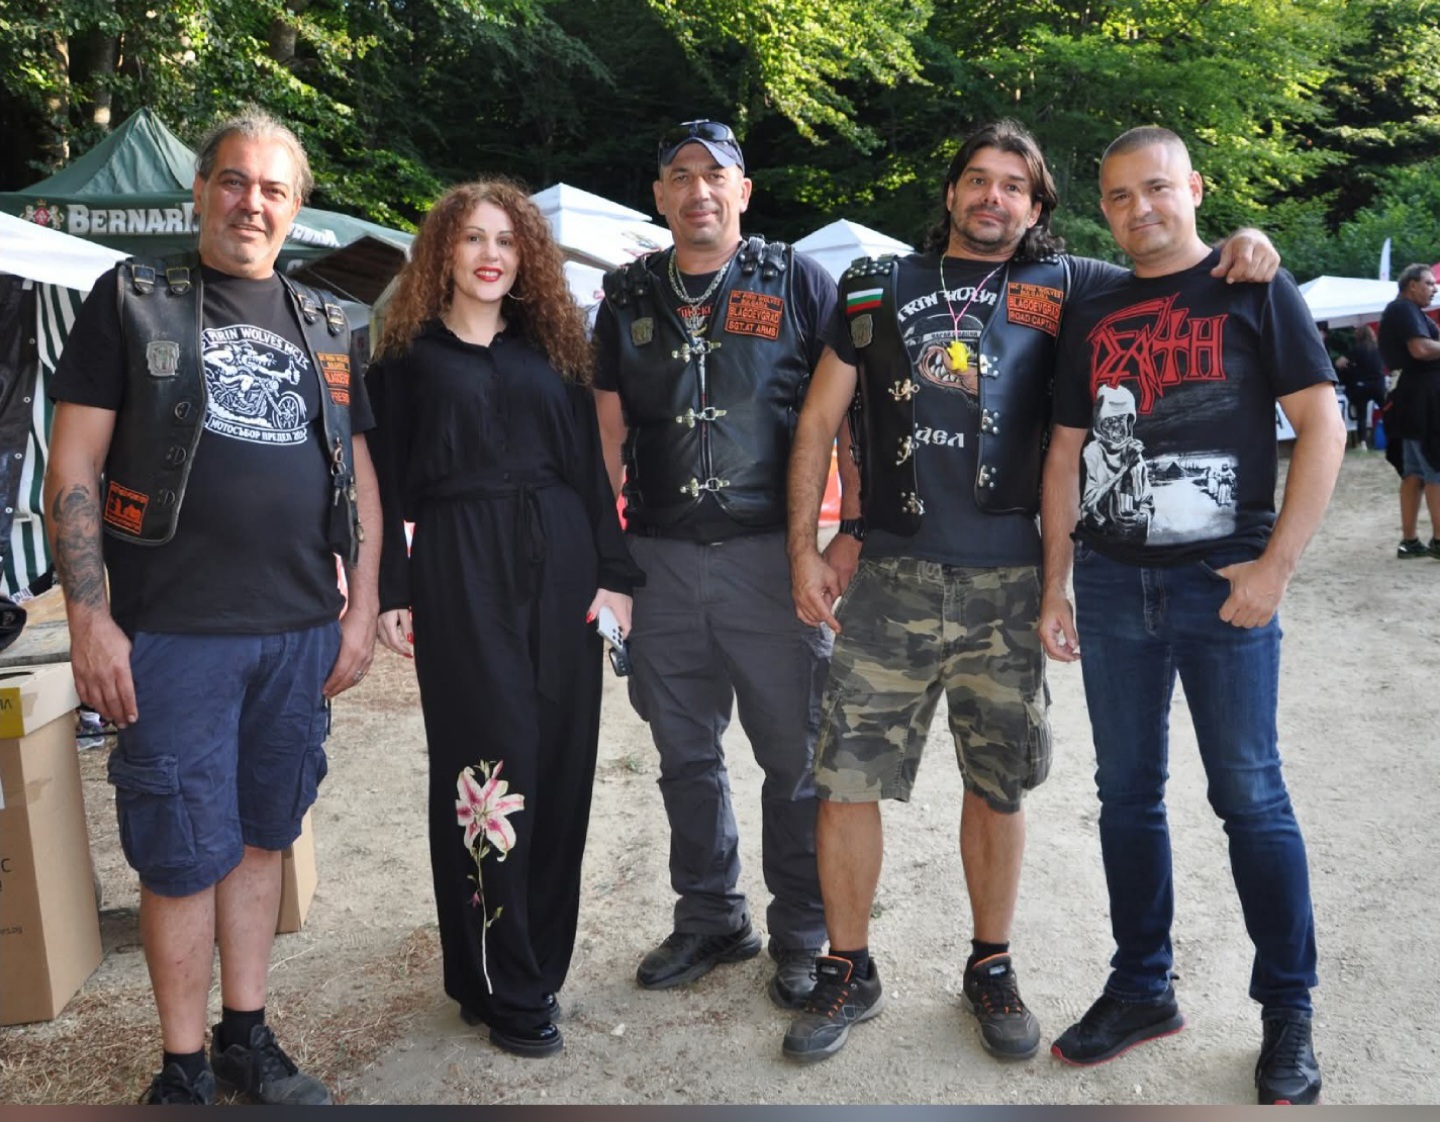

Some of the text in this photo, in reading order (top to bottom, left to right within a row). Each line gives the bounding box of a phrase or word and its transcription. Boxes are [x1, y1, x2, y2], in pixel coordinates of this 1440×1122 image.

[729, 307, 779, 323] BLAGOEVGRAD
[897, 291, 939, 322] IRIN
[1008, 296, 1060, 319] BLAGOEVGRAD
[1009, 311, 1030, 322] ROAD
[240, 327, 283, 349] WOLVES
[756, 324, 776, 337] ARMS
[1086, 292, 1228, 414] DEATH
[210, 419, 261, 439] МОТОСЪБОР
[262, 432, 293, 442] ПРЕДЕЛ
[914, 422, 965, 448] дел
